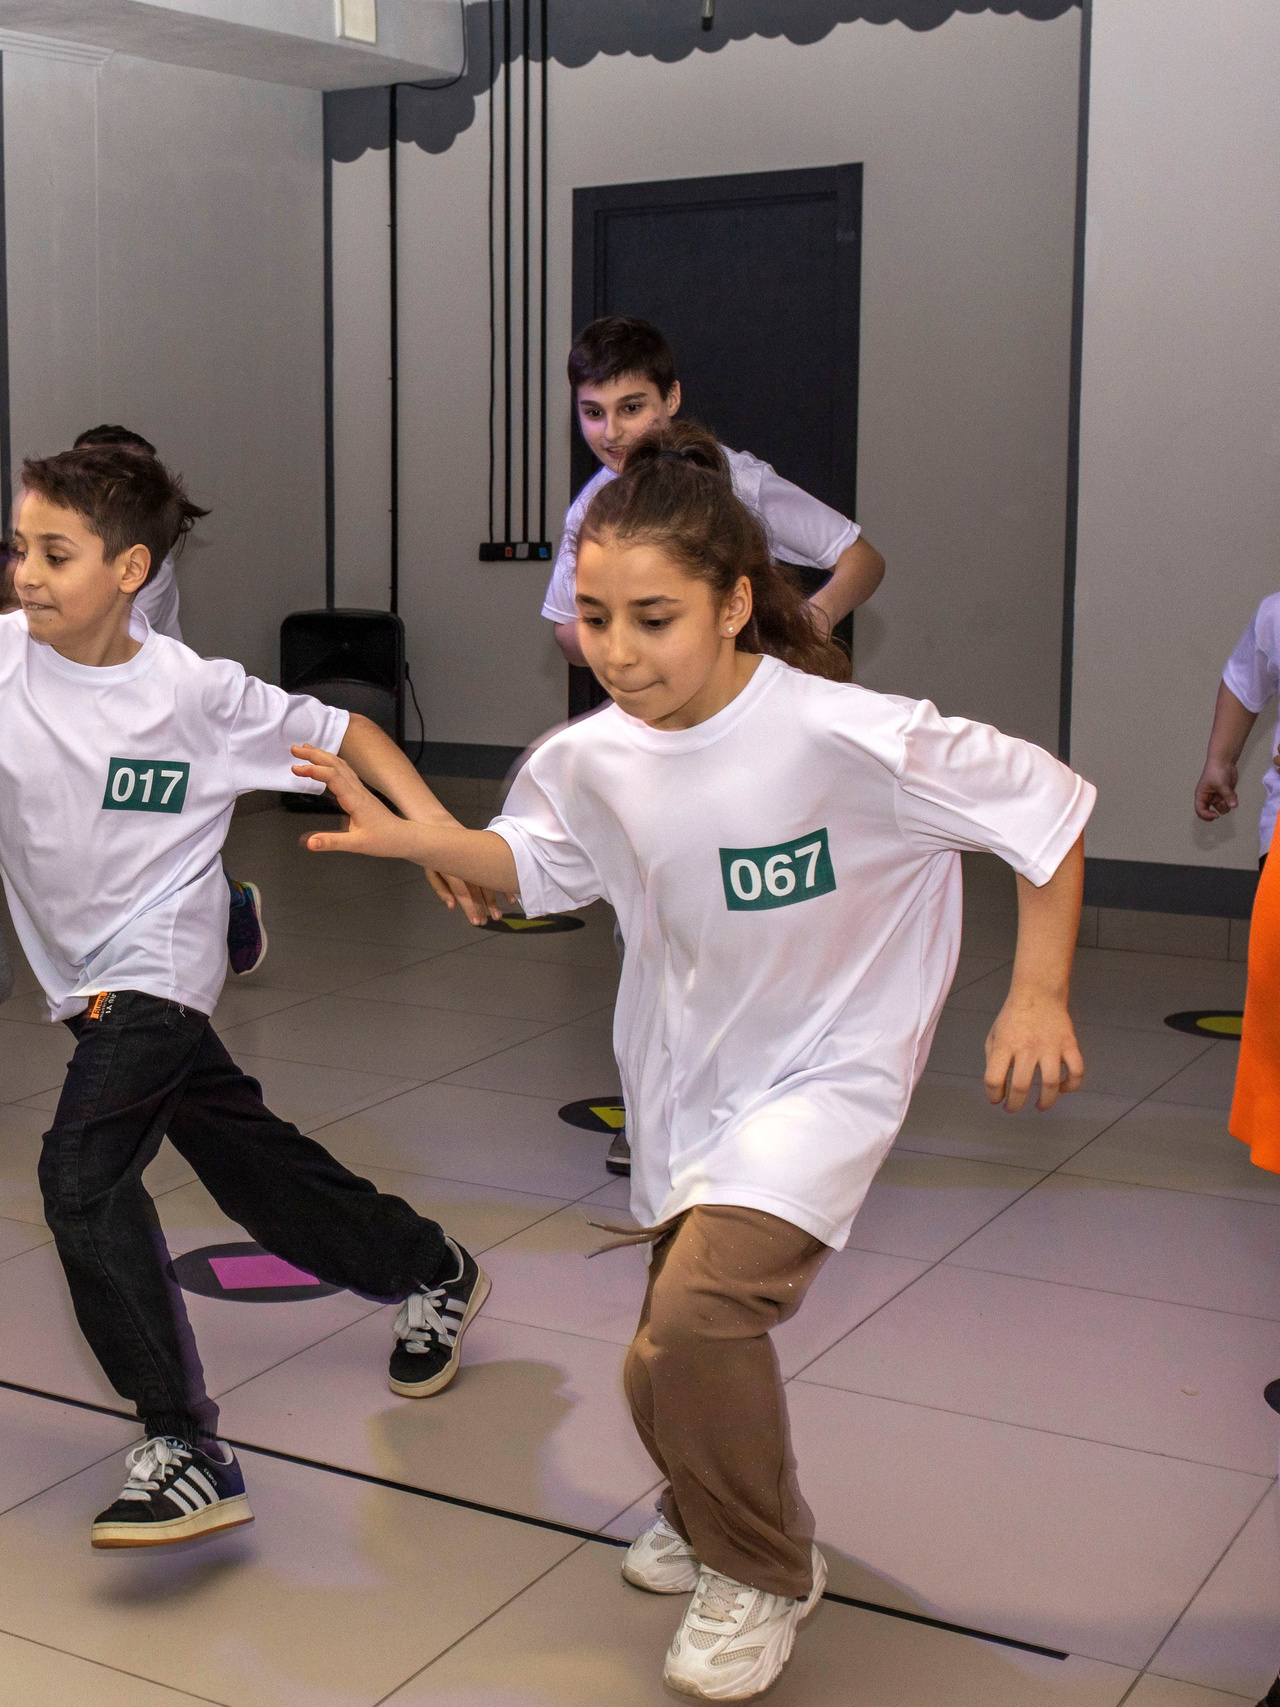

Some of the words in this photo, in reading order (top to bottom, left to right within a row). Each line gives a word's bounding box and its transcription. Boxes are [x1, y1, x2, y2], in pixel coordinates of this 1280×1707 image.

[111, 767, 184, 805] 017
[730, 840, 822, 901] 067
[204, 1468, 218, 1486] CAMPUS
